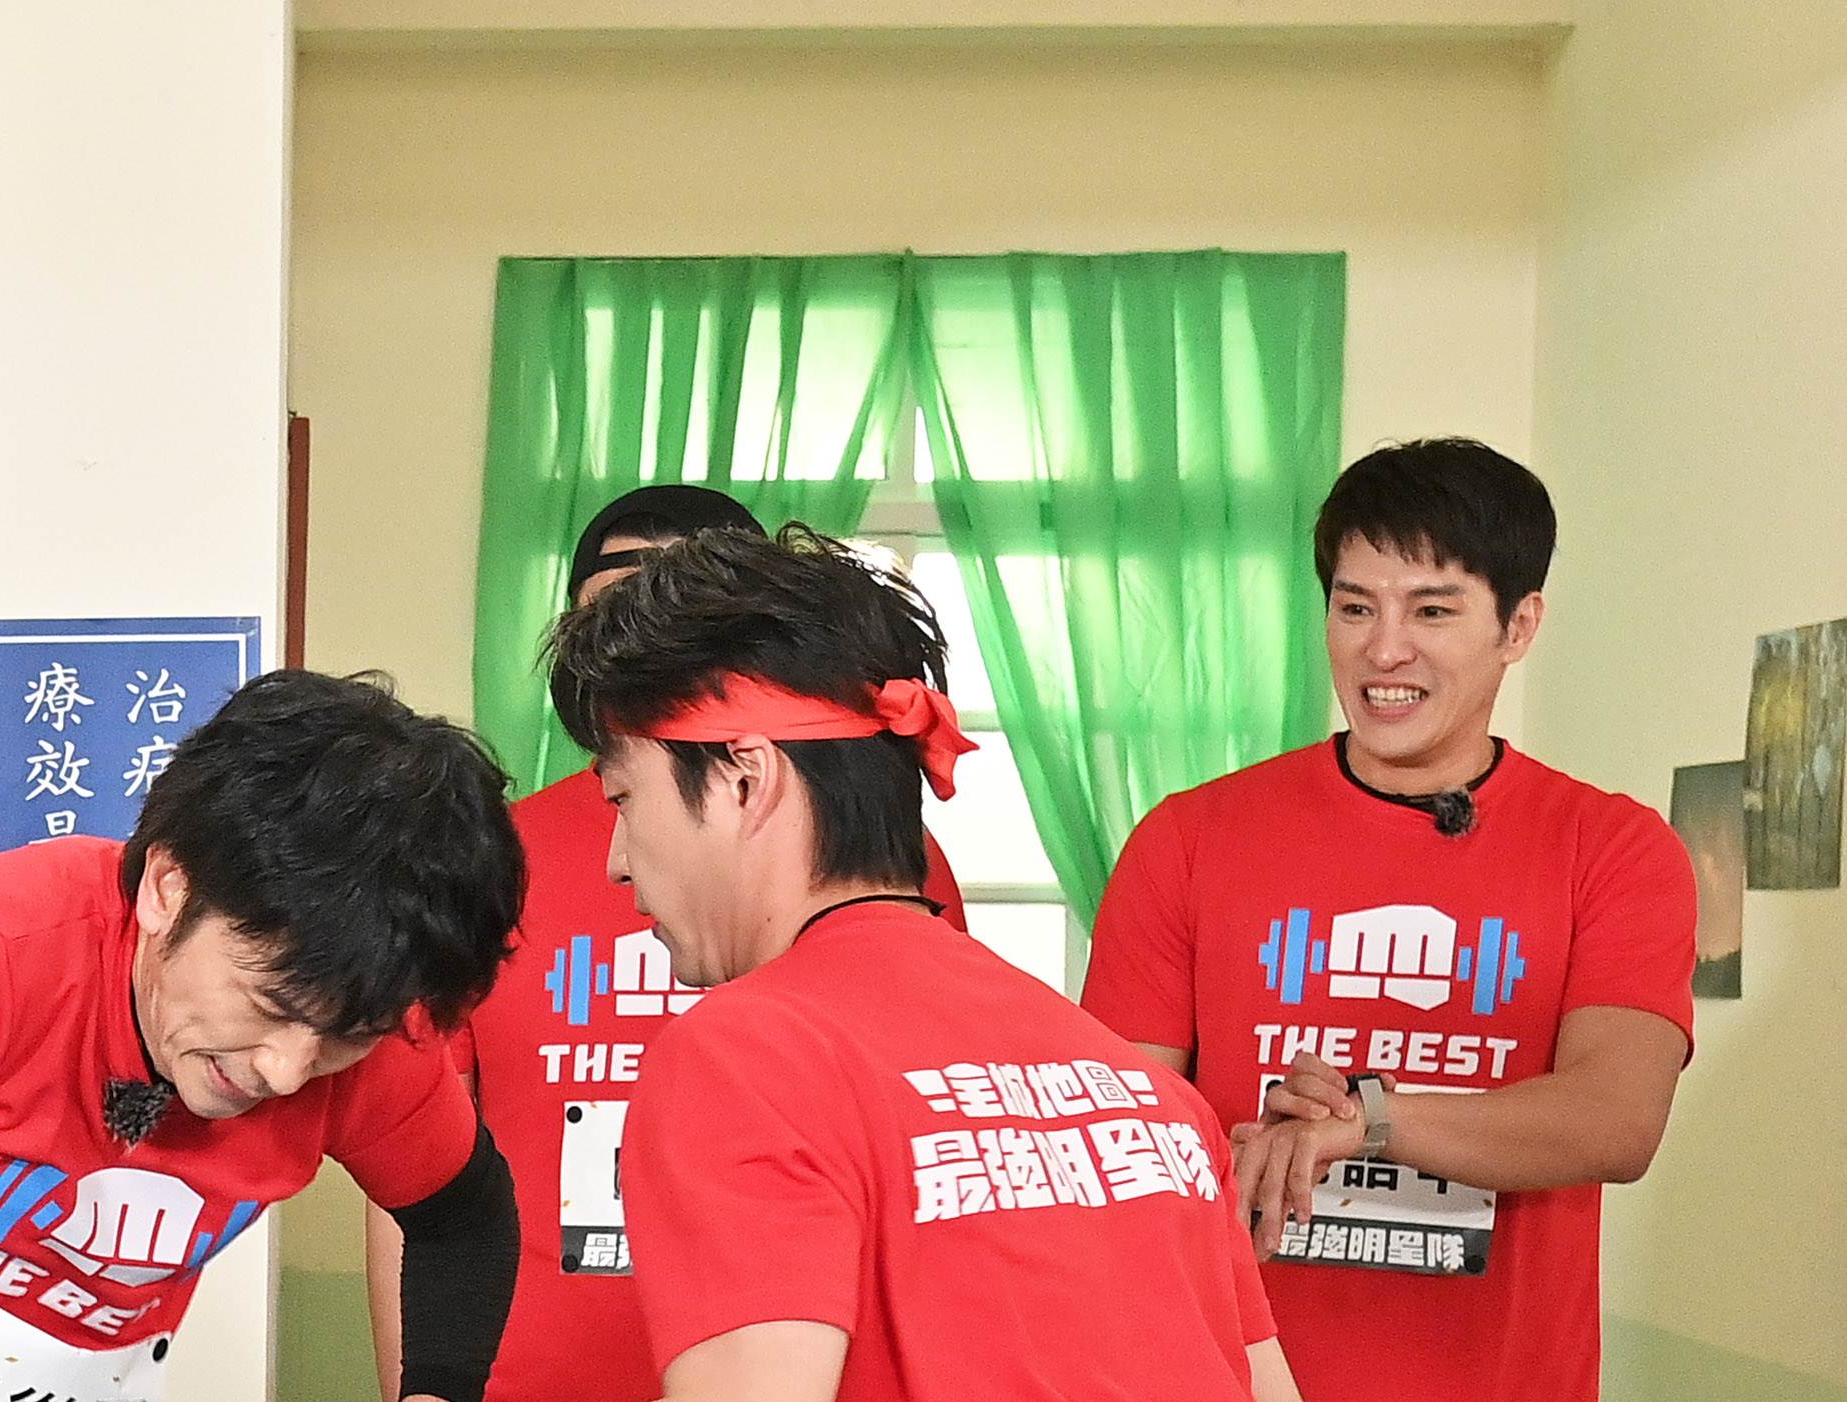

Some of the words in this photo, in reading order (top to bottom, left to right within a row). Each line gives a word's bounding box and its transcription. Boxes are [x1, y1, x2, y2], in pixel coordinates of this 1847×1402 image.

[539, 1044, 645, 1083] THE
[1253, 1024, 1357, 1067] THE
[1366, 1030, 1519, 1080] BEST
[910, 1118, 1220, 1225] 最強明星隊
